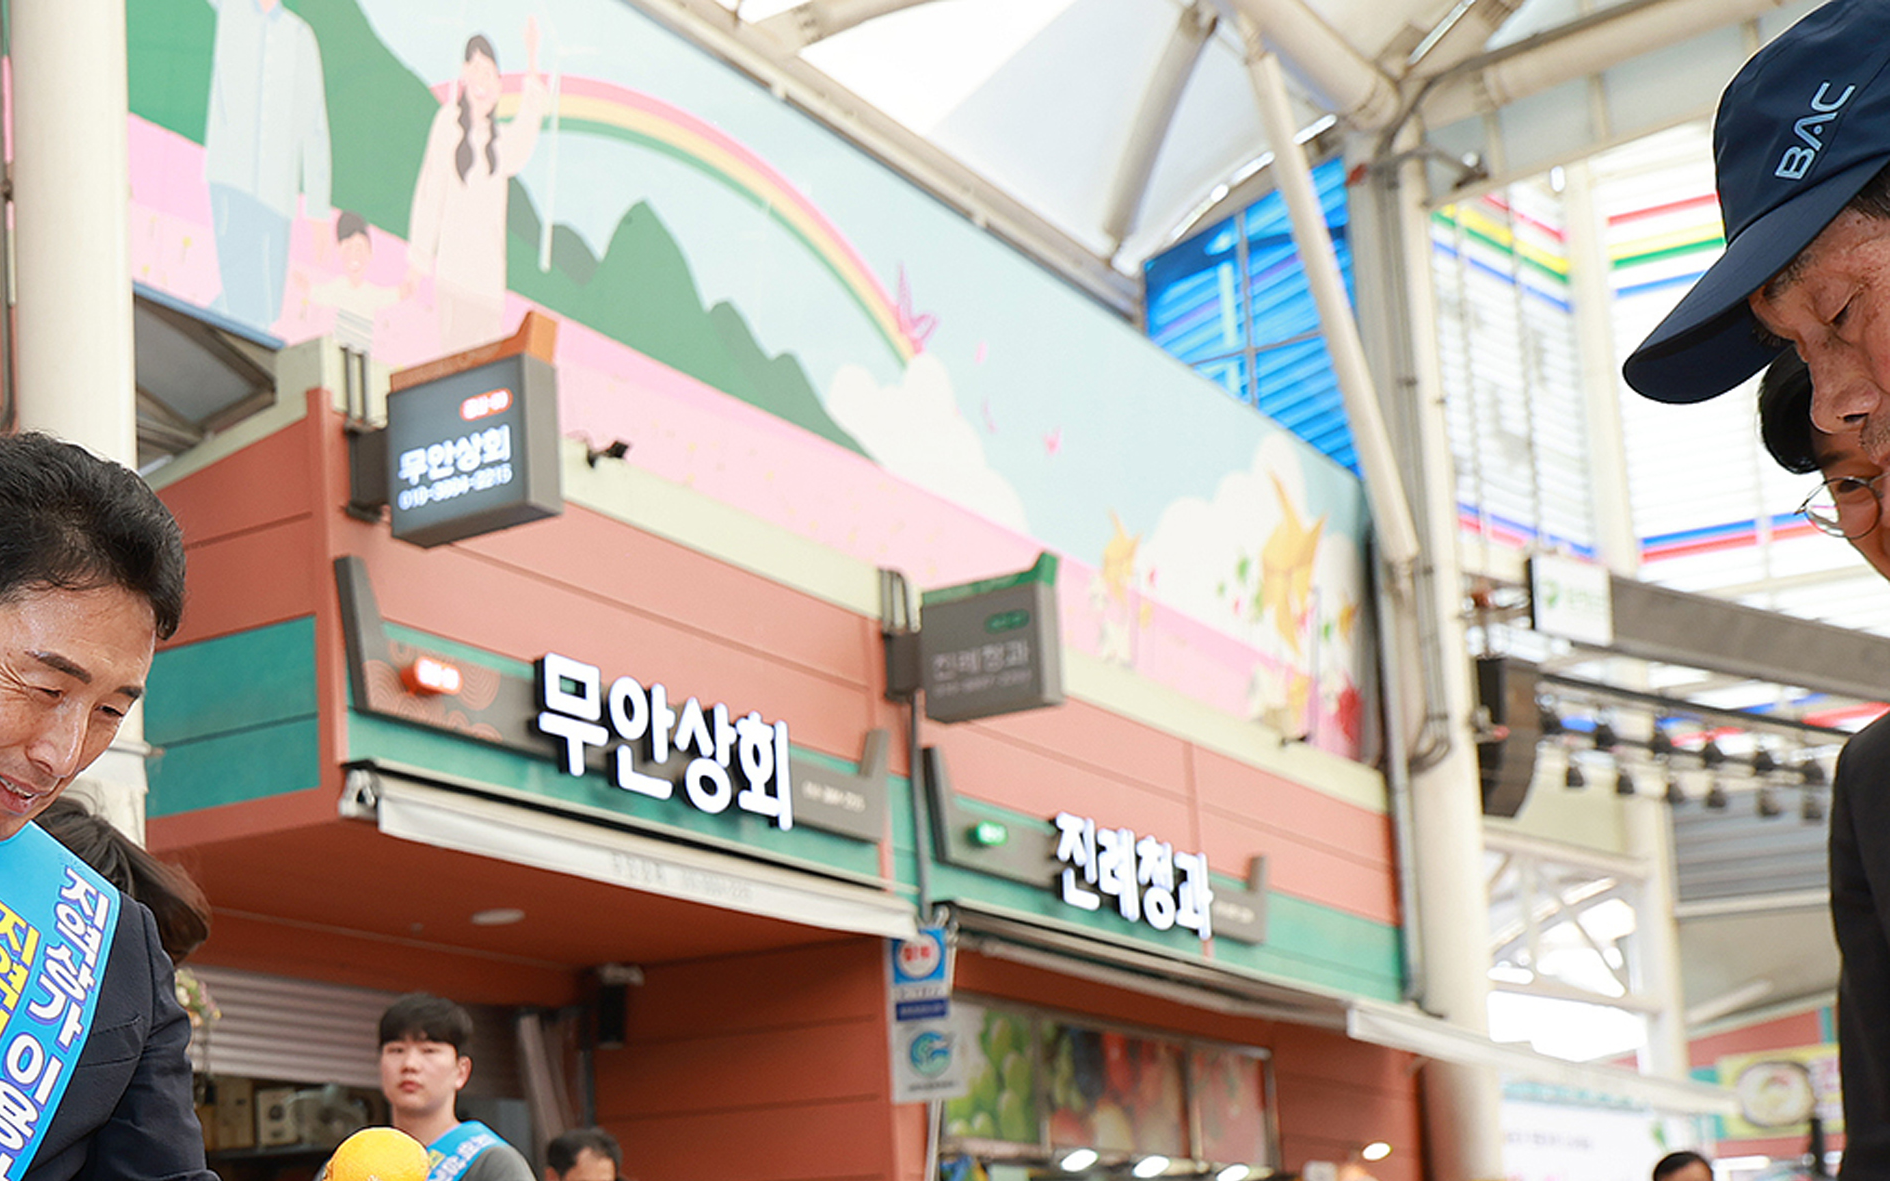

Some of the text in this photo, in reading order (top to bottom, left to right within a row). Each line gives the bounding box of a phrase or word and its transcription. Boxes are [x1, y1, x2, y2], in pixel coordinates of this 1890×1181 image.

[1775, 82, 1855, 180] BAC
[397, 424, 511, 486] 무안상회
[536, 651, 793, 832] 무안상회
[27, 867, 110, 1048] 지역상가
